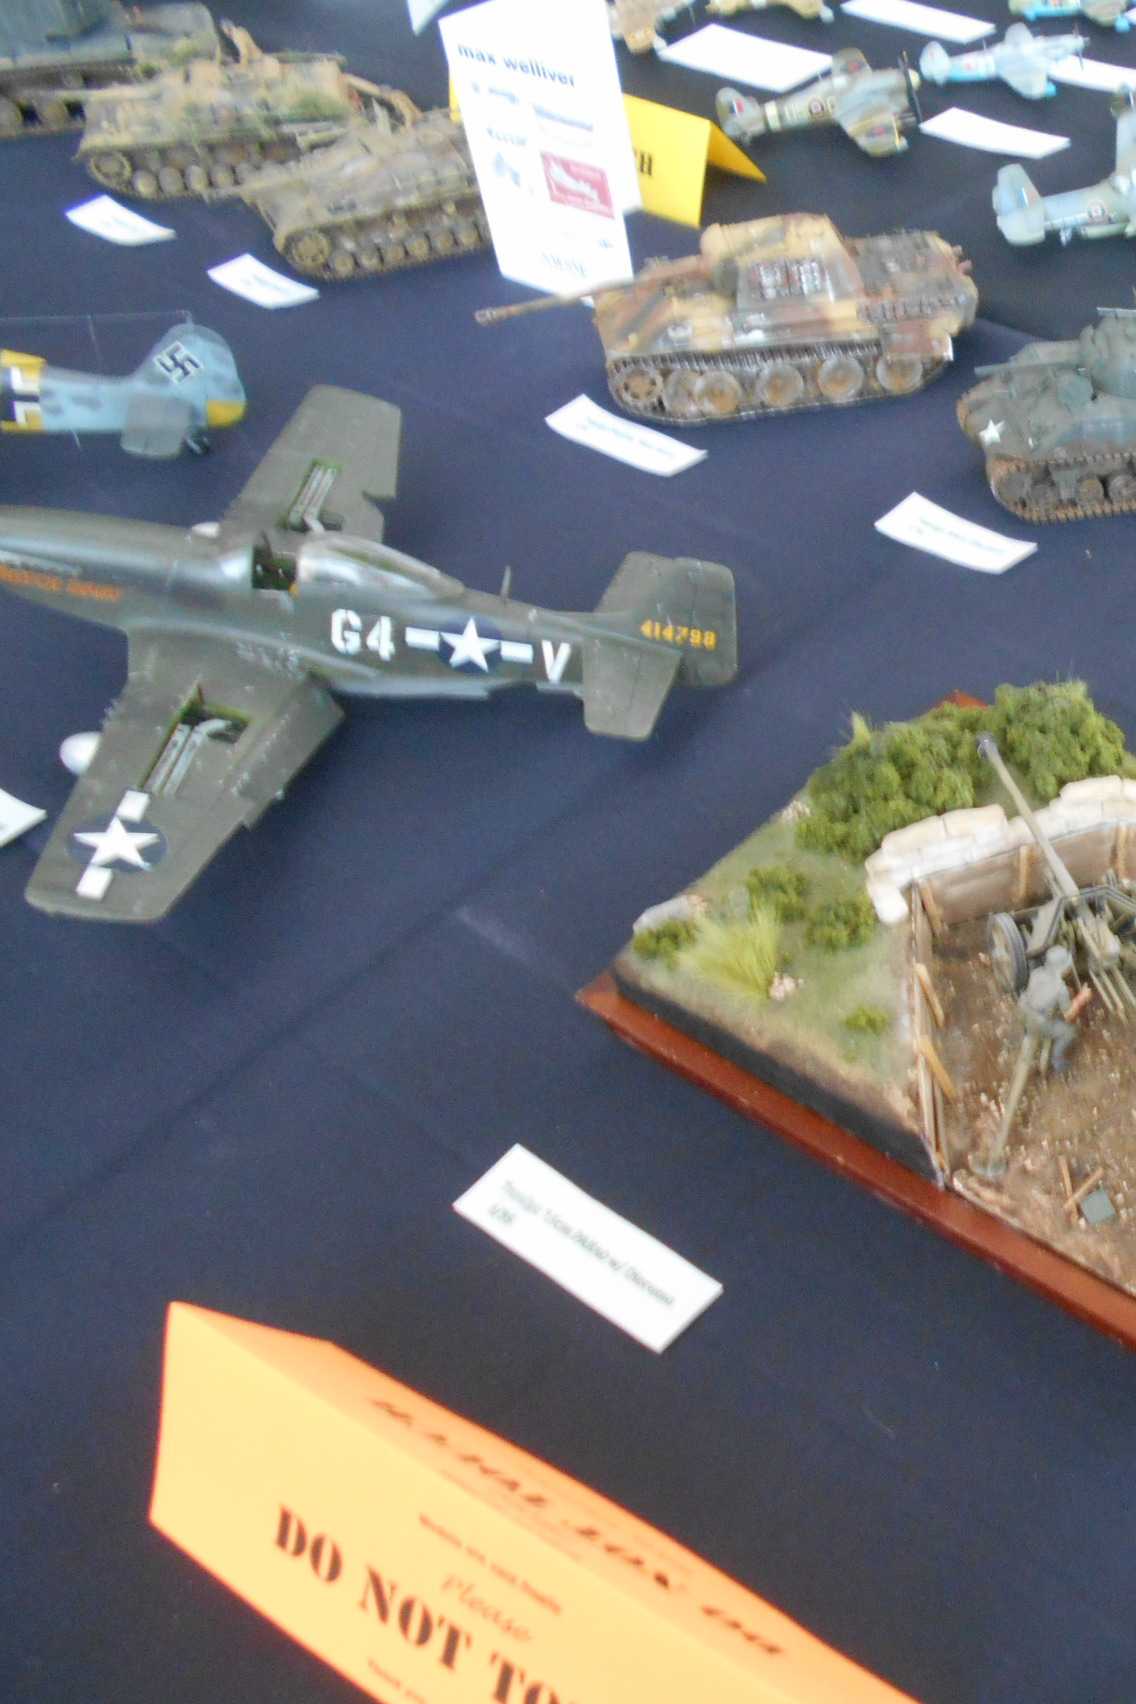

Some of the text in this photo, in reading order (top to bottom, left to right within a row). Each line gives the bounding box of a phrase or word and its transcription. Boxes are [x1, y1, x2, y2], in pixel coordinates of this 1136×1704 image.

[457, 44, 497, 66] max
[503, 57, 576, 88] welliver
[331, 608, 396, 662] G4
[640, 619, 718, 652] 414798
[541, 639, 572, 684] V
[275, 1503, 344, 1585] DO
[358, 1563, 473, 1673] NOT
[440, 1573, 533, 1643] Please
